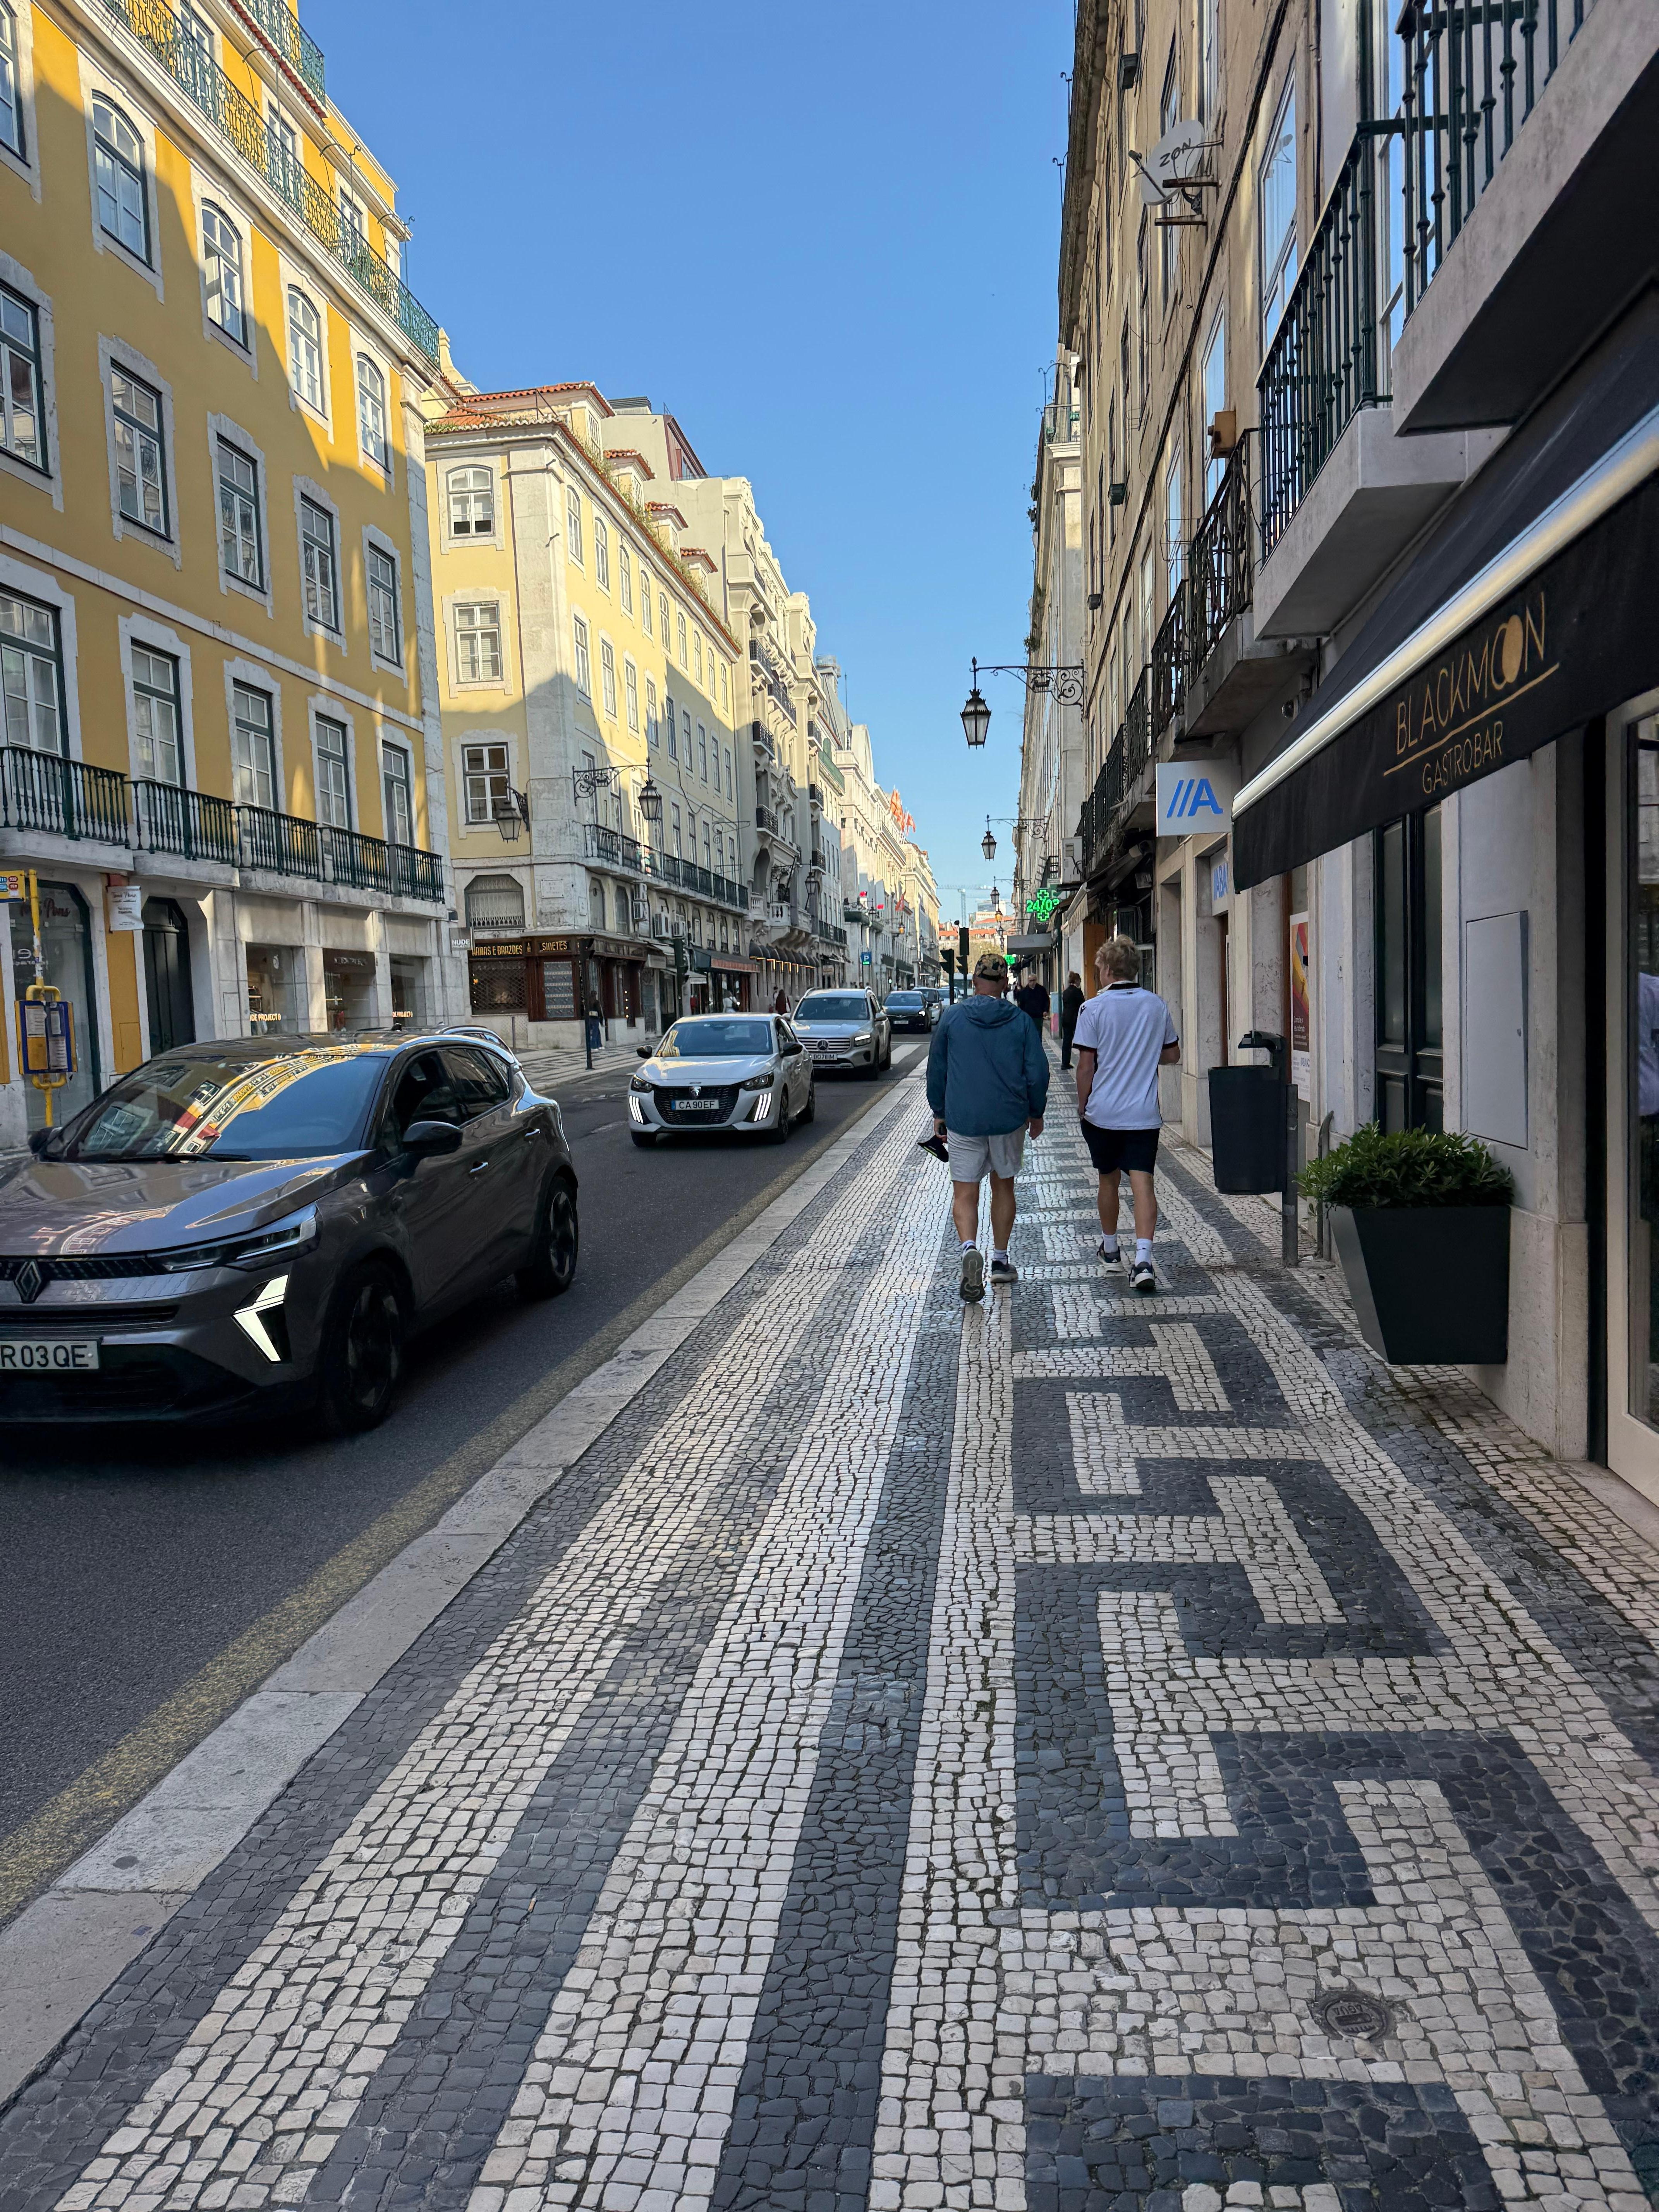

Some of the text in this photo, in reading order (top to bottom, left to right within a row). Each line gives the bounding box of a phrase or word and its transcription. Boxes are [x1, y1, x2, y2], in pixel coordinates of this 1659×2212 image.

[1159, 137, 1191, 167] ZON
[1422, 721, 1503, 793] GASTROBAR
[492, 946, 496, 955] E
[542, 941, 567, 951] SINETES
